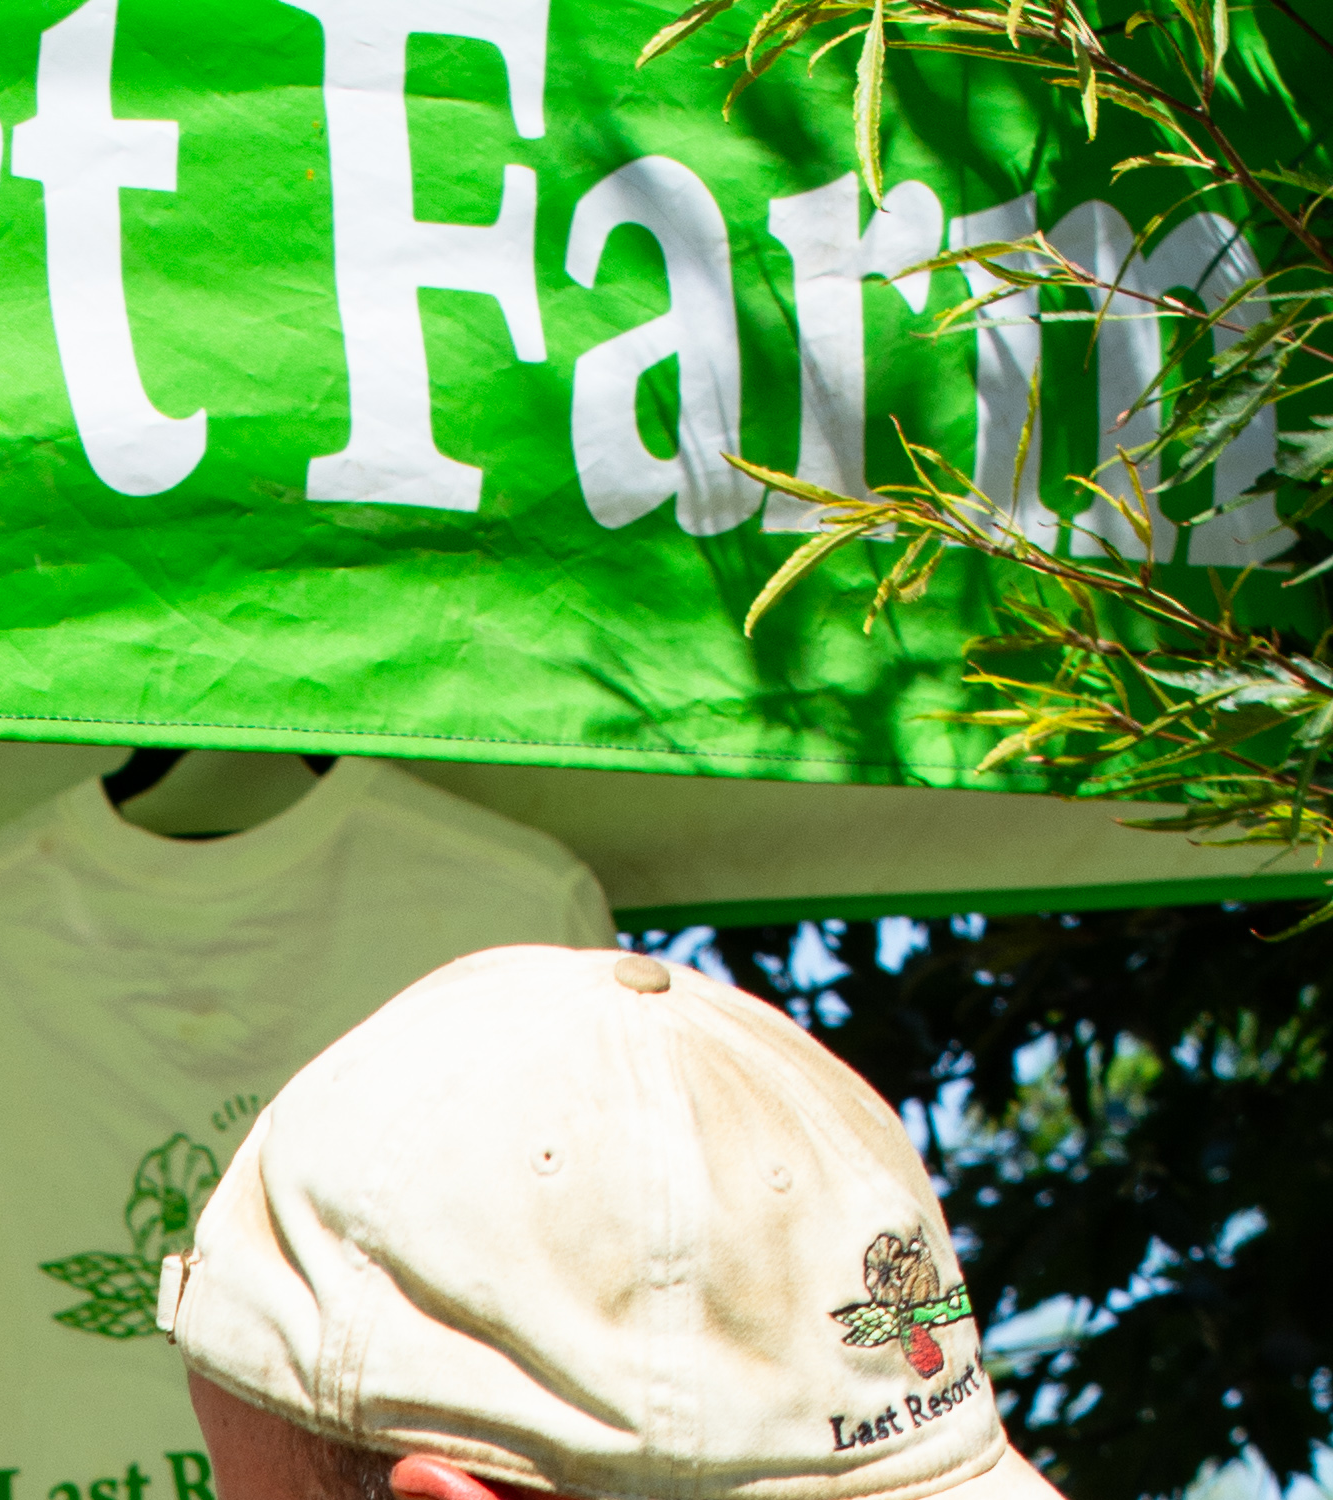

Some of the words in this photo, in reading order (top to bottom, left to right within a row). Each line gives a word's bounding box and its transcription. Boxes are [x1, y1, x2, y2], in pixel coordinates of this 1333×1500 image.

[306, 0, 1298, 568] Farm
[829, 1403, 904, 1452] Last
[904, 1364, 981, 1429] Resort
